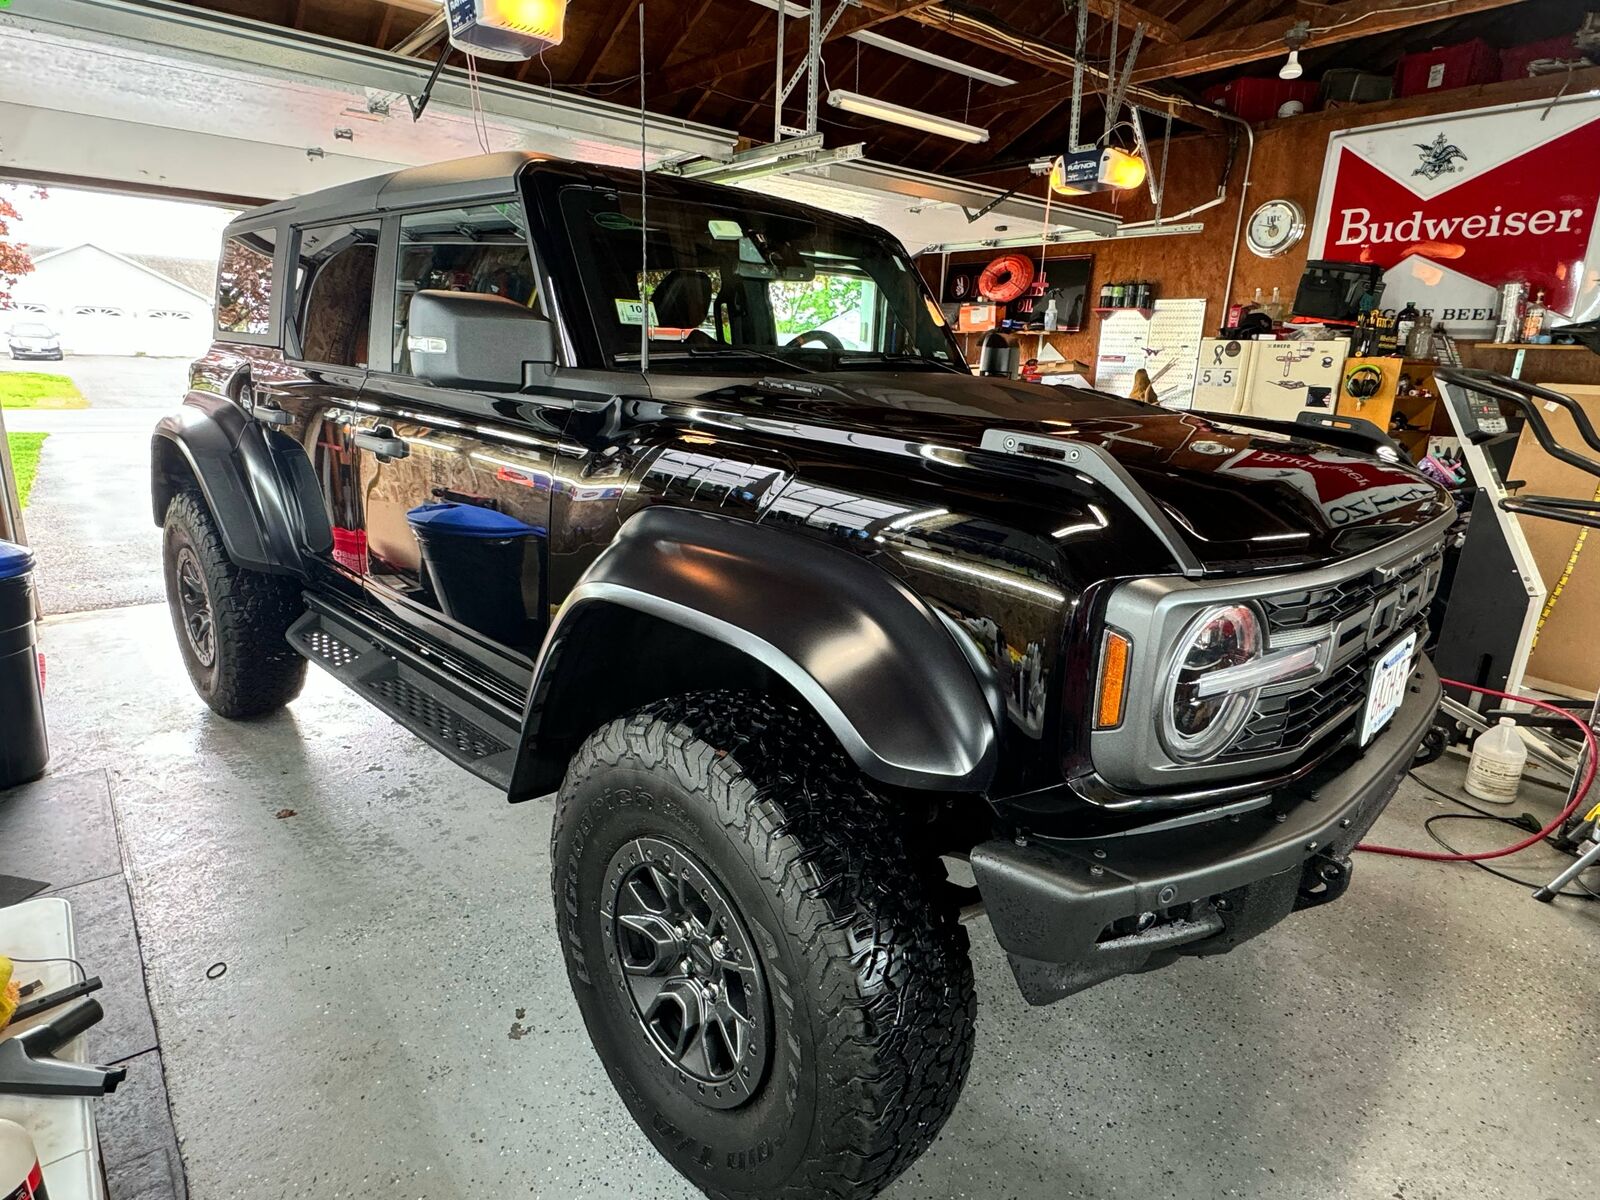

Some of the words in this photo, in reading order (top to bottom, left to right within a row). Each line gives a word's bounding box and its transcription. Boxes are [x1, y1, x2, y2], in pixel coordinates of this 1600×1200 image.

[1067, 161, 1097, 171] RAYNOR
[1335, 206, 1583, 246] Budweiser
[1203, 370, 1212, 383] 5
[1223, 370, 1232, 384] 5
